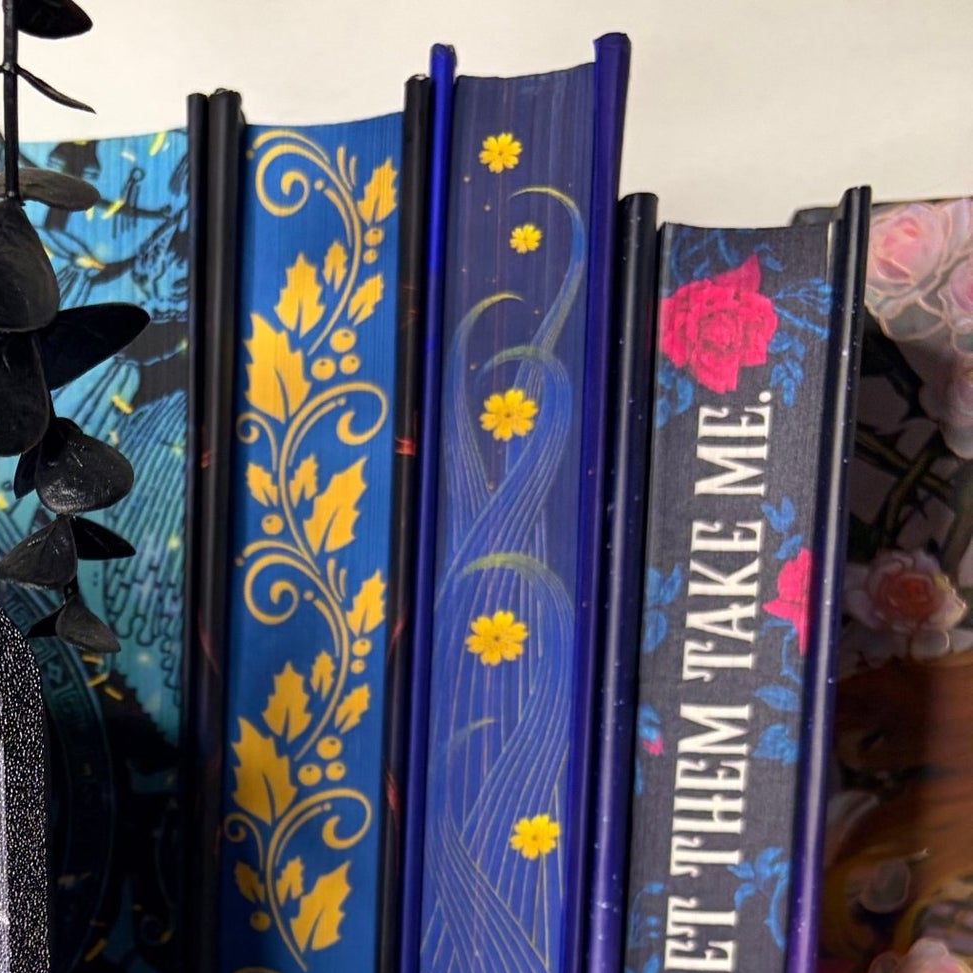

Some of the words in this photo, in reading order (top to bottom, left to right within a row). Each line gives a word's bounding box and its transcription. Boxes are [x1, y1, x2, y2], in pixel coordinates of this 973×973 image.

[694, 390, 773, 497] ME.
[682, 520, 765, 683] TAKE
[669, 702, 753, 879] THEM
